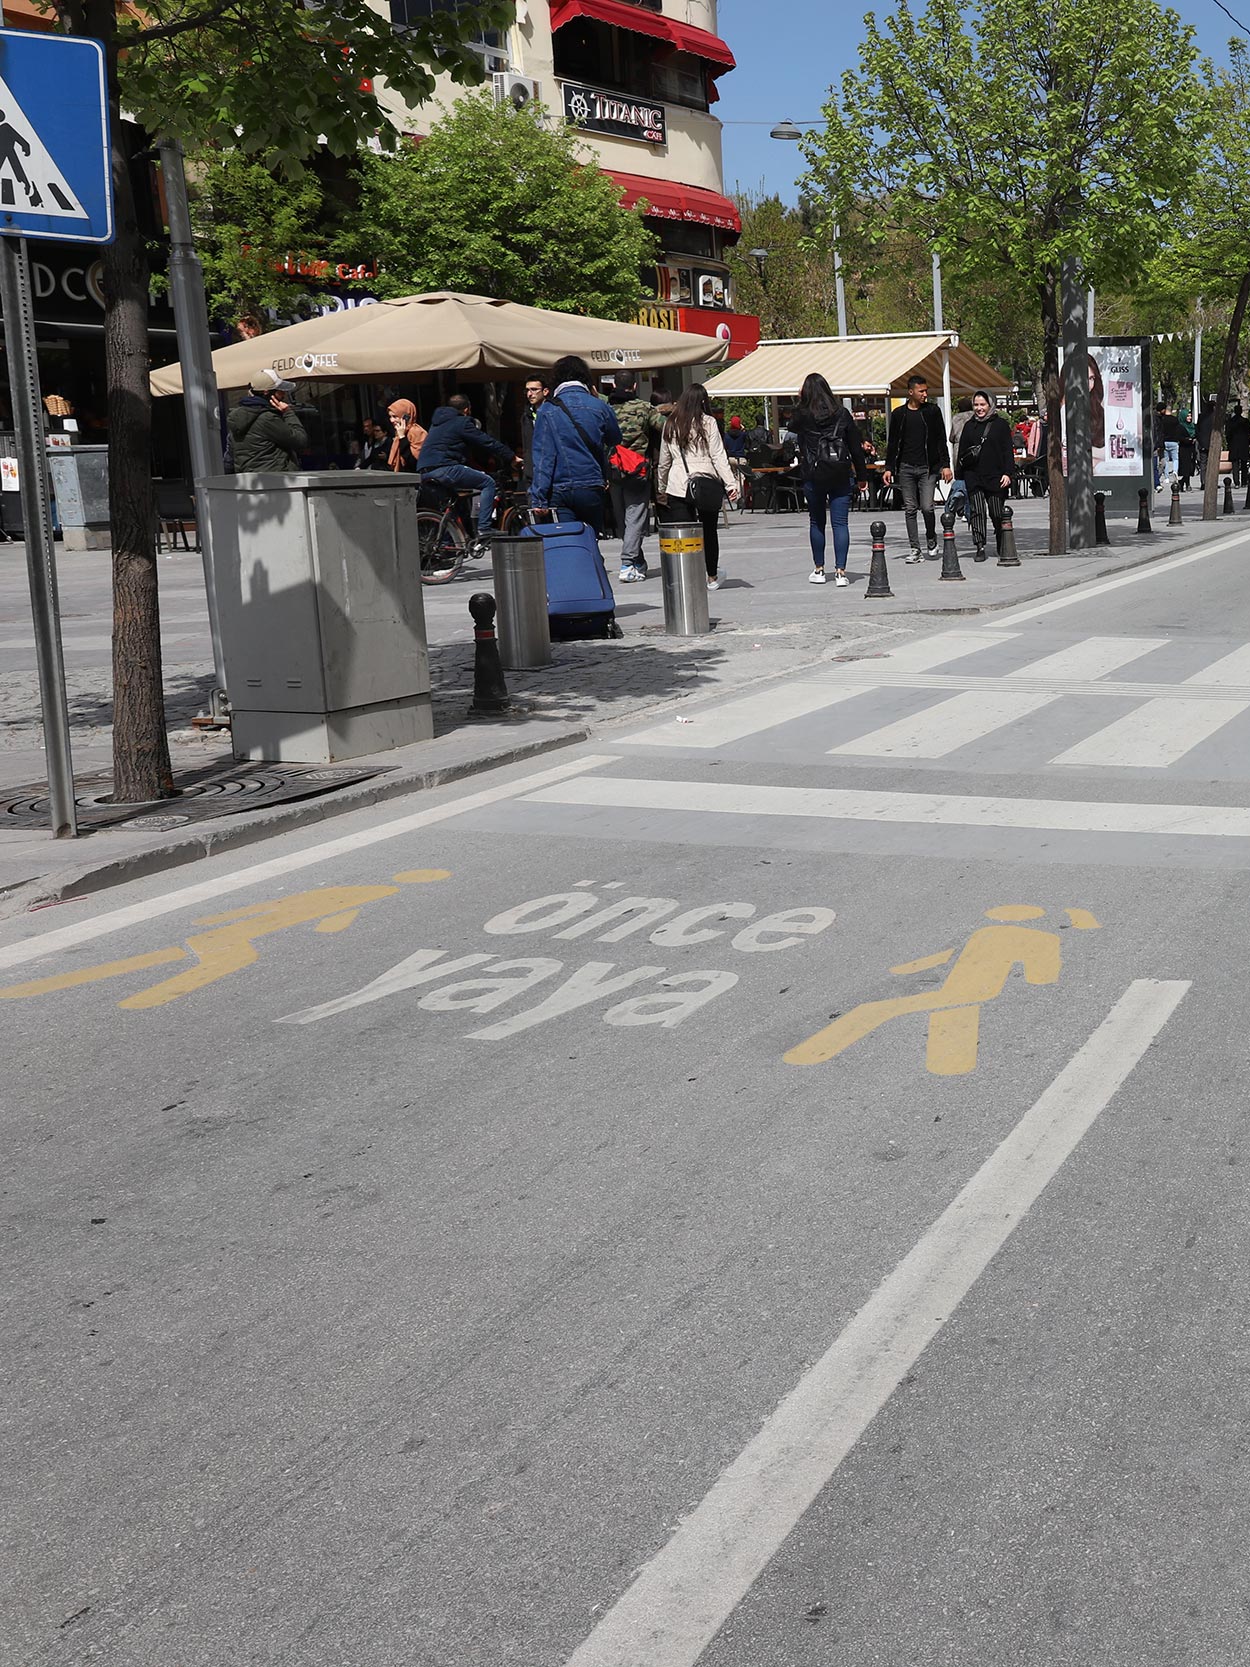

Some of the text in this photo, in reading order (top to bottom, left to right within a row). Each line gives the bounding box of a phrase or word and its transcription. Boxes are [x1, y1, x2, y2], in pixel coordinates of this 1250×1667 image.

[591, 93, 662, 130] TITANIC
[1111, 365, 1130, 374] GLISS
[483, 880, 836, 952] önce
[273, 949, 739, 1040] yaya
